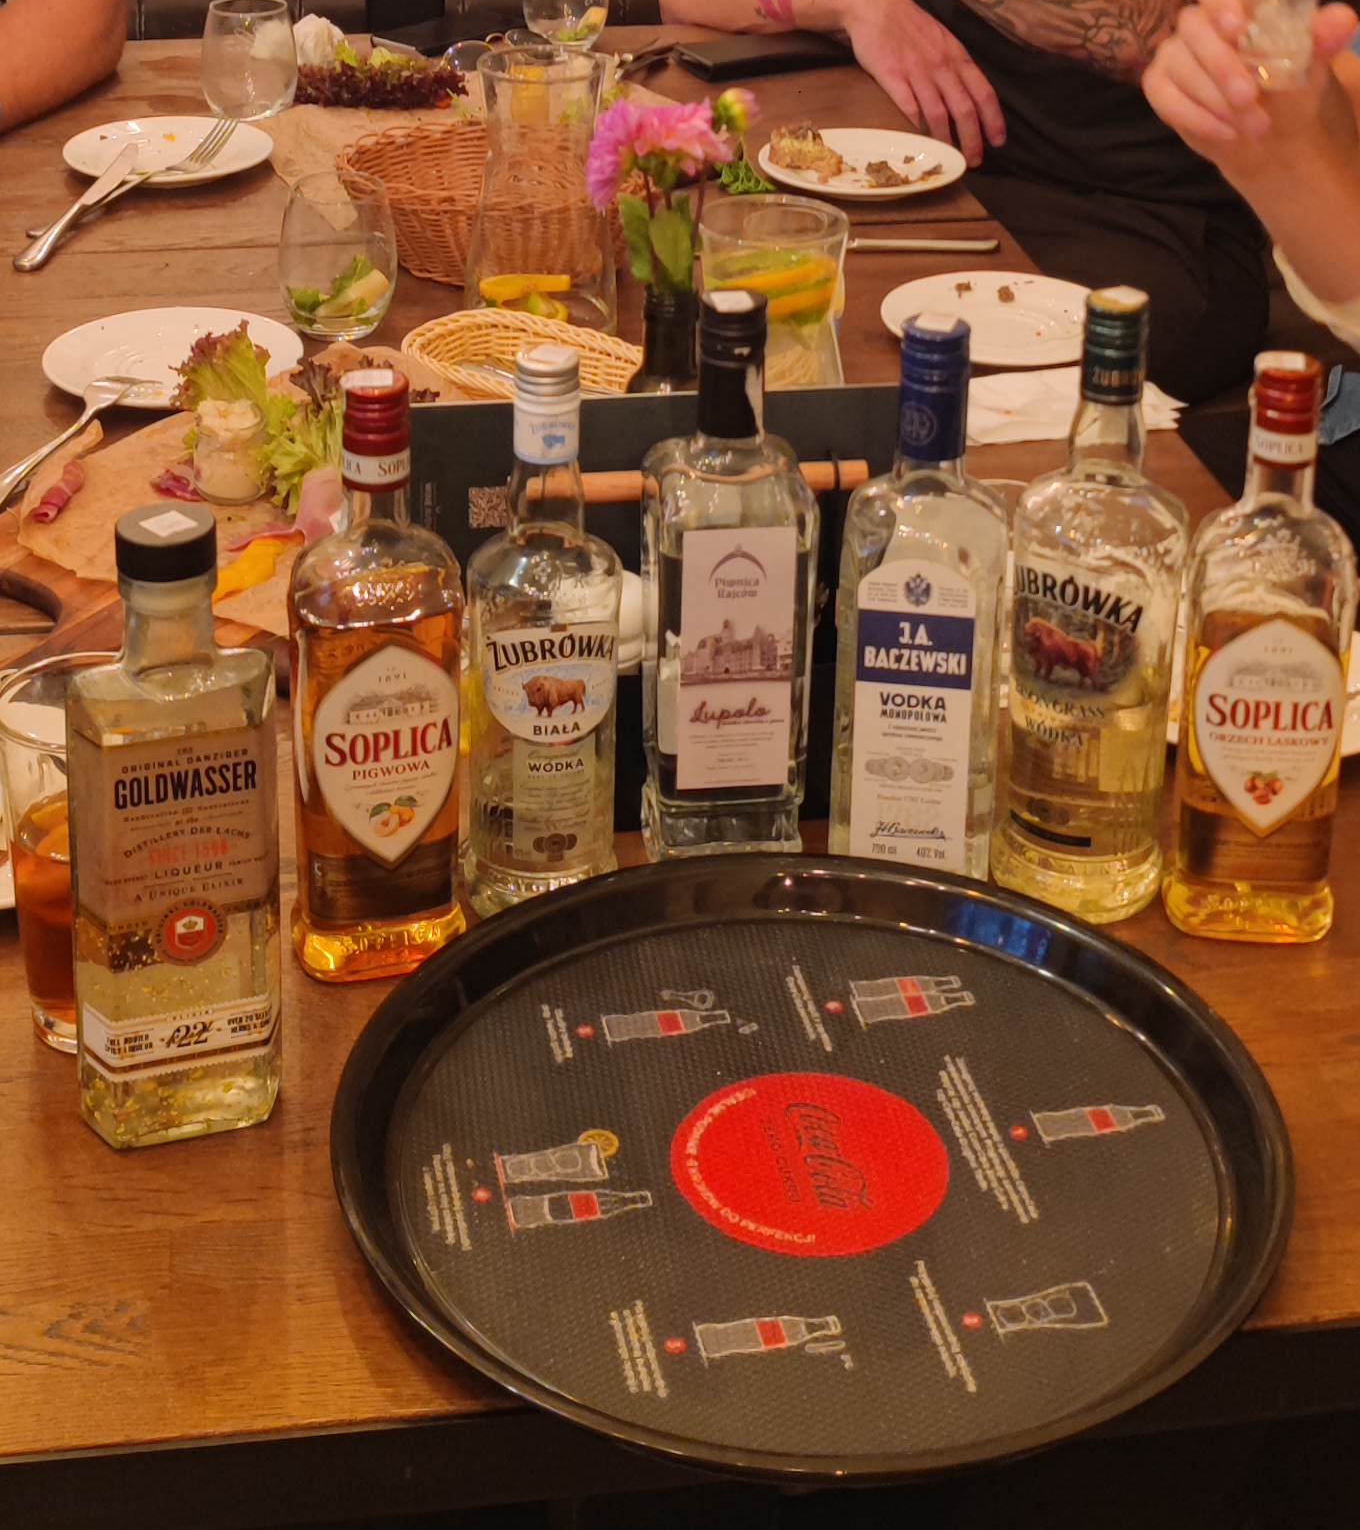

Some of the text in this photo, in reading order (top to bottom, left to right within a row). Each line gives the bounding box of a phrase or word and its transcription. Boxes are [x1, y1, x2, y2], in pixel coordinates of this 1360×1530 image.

[898, 620, 934, 646] J.A.
[485, 632, 616, 672] ŻUBRÓWKA
[863, 645, 967, 676] BACZEWSKI
[879, 691, 947, 711] VODKA
[1205, 692, 1333, 732] SOPLICA
[324, 715, 453, 768] SOPLICA
[533, 721, 581, 737] BIAŁA
[121, 748, 249, 775] ORIGINAL DANZIGER
[352, 759, 431, 781] PIGWOWA
[114, 759, 258, 810] GOLDWASSER
[154, 861, 224, 880] LIQUEUR
